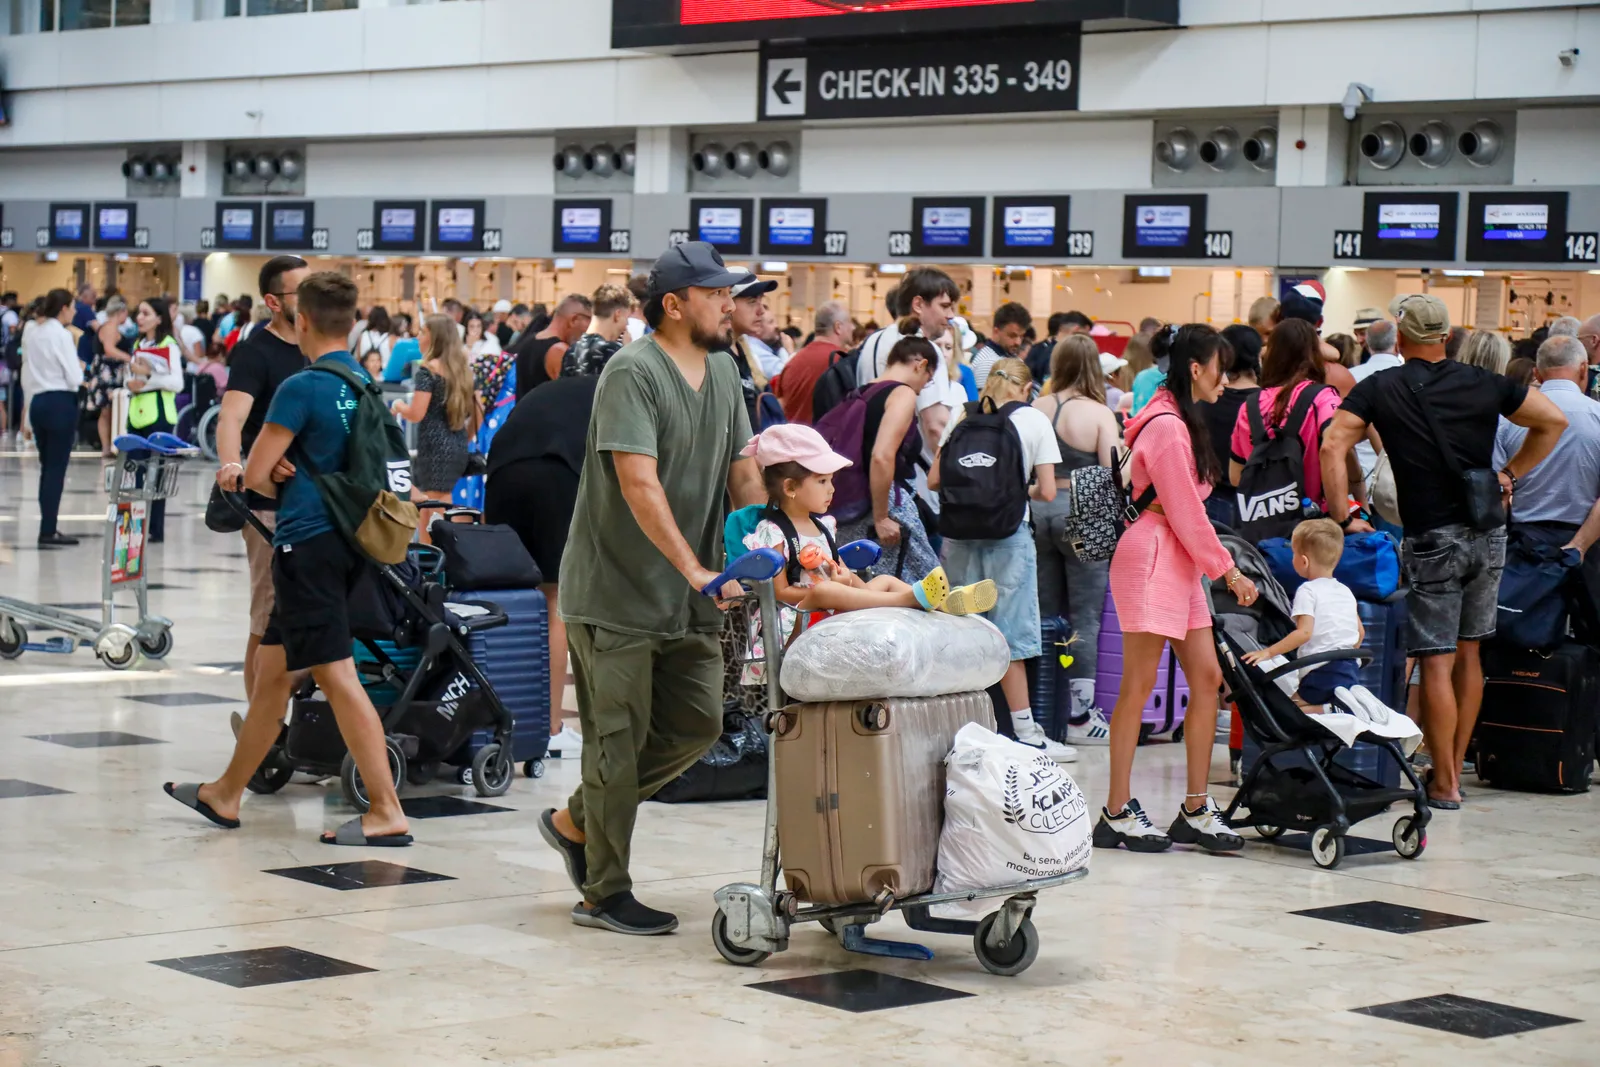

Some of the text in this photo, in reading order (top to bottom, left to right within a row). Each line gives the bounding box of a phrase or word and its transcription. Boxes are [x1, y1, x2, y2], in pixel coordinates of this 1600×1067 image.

[819, 66, 946, 100] CHECK-IN
[953, 63, 999, 95] 335
[1023, 59, 1072, 92] 349
[482, 230, 499, 249] 134
[610, 231, 628, 250] 135
[824, 232, 845, 253] 137
[1067, 232, 1092, 255] 139
[1204, 232, 1230, 256] 140
[1334, 232, 1361, 257] 141
[1566, 235, 1596, 260] 142
[1237, 481, 1300, 522] VANS
